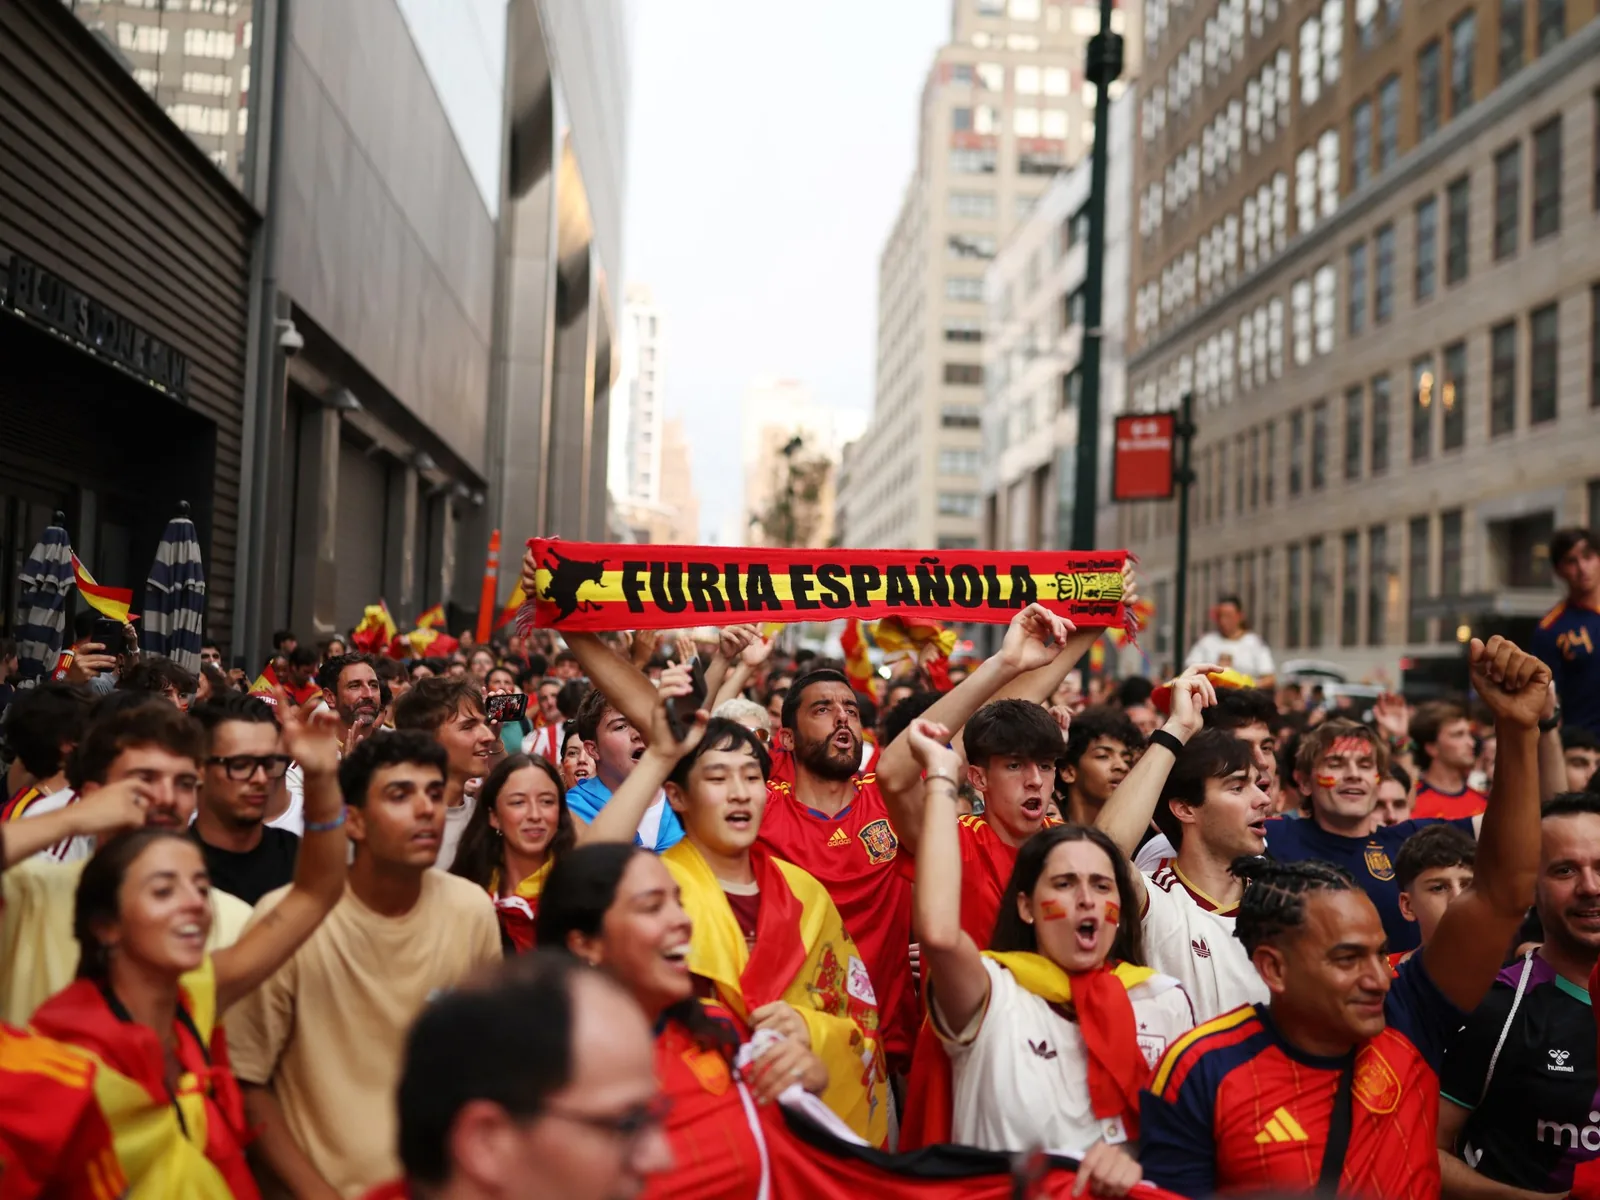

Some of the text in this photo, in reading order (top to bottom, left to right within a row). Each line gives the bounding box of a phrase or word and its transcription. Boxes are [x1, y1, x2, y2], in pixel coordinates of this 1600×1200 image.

[621, 556, 1038, 614] FURIA ESPAÑOLA
[1556, 625, 1594, 661] 24
[827, 837, 852, 847] adidas
[1547, 1063, 1575, 1073] hummel
